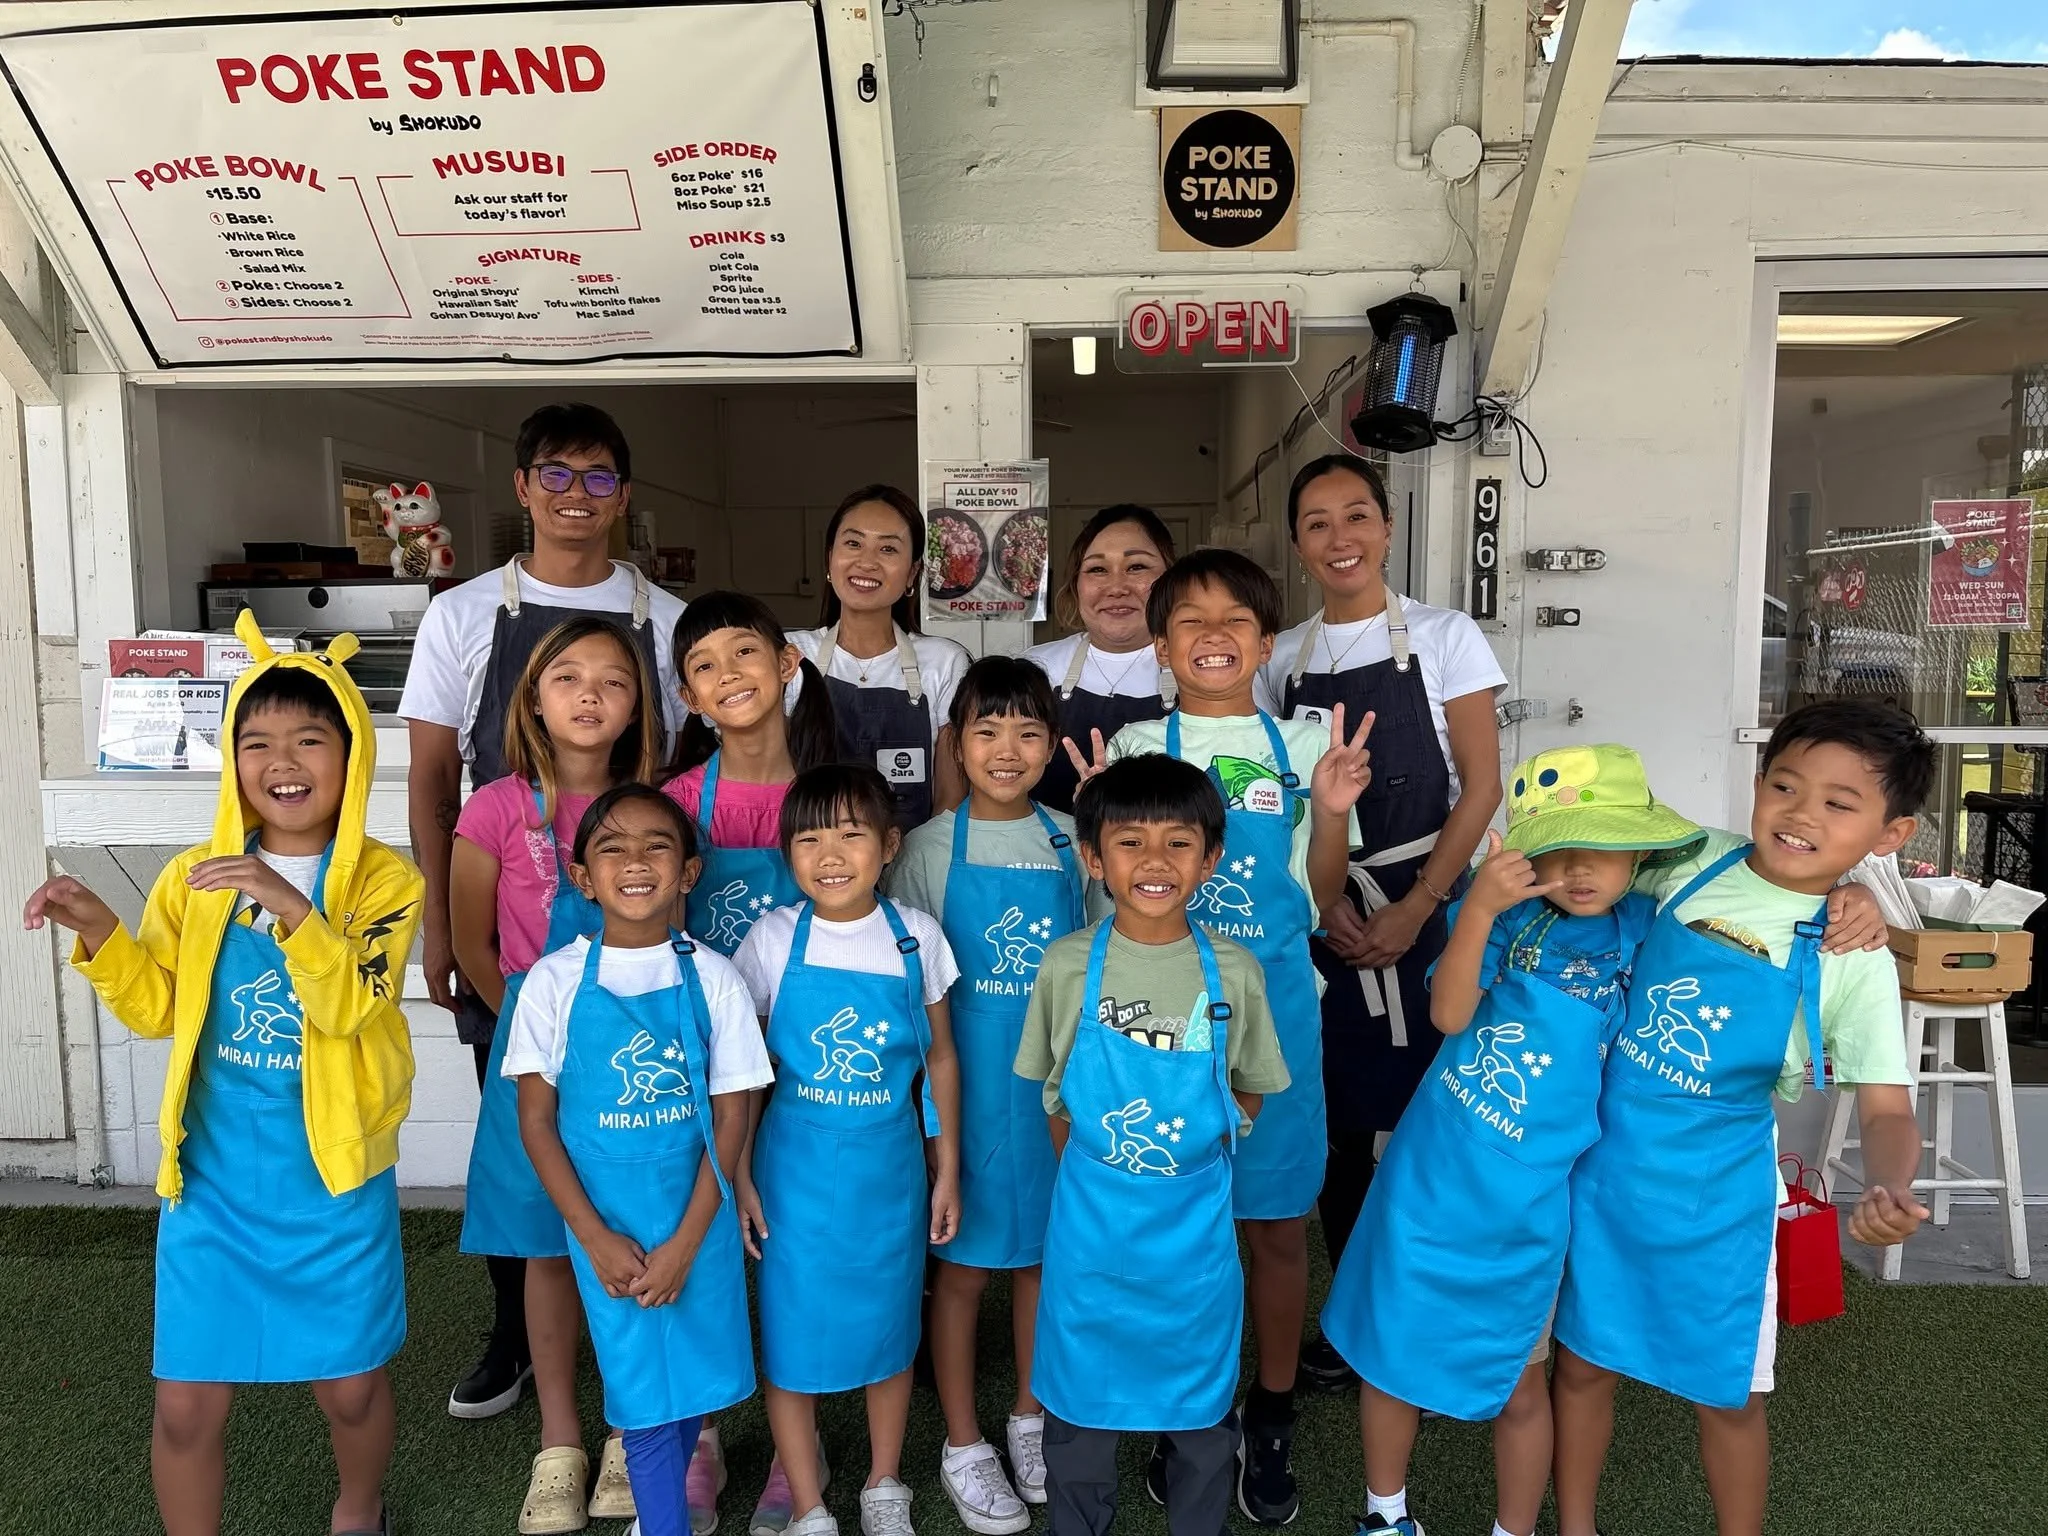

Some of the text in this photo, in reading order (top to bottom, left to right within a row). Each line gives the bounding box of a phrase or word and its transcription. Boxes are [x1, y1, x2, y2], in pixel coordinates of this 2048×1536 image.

[216, 44, 606, 103] POKE STAND
[369, 114, 482, 135] by SHOKUDO
[653, 142, 777, 168] SIDE ORDER
[1188, 145, 1271, 170] POKE
[432, 150, 565, 180] MUSUBI
[134, 155, 326, 193] POKE BOWL
[671, 172, 696, 182] 6oz
[741, 168, 763, 179] $16
[206, 186, 262, 200] $15.50
[674, 186, 699, 197] 8oz
[743, 183, 765, 193] $21
[1180, 176, 1278, 202] STAND
[454, 192, 568, 205] Ask our staff for
[677, 197, 771, 211] Miso Soup $2.5
[225, 212, 274, 225] Base:
[464, 207, 566, 221] today's flavor!
[1195, 207, 1263, 220] by SHOKUDO
[221, 231, 296, 241] White Rice
[689, 230, 786, 249] DRINKS $3
[228, 247, 304, 258] Brown Rice
[478, 248, 582, 268] SIGNATURE
[719, 252, 745, 260] Cola
[243, 263, 306, 273] Salad Mix
[709, 263, 759, 272] Diet Cola
[455, 276, 491, 285] POKE
[577, 274, 614, 283] SIDES
[720, 274, 753, 283] Sprite
[231, 279, 281, 291] Poke:
[283, 281, 332, 291] Choose
[334, 281, 344, 290] 2
[578, 286, 620, 296] Kimchi
[712, 285, 764, 294] POG juice
[432, 288, 479, 298] Original
[240, 296, 290, 308] Sides:
[292, 298, 342, 307] Choose
[343, 298, 353, 307] 2
[438, 299, 492, 309] Hawaiian
[544, 296, 661, 308] Tofu with bonito flakes
[708, 295, 781, 304] Green tea $3.5
[430, 311, 468, 320] Gohan
[469, 310, 515, 321] Desuyo!
[576, 308, 635, 319] Mac Salad
[701, 306, 787, 315] Bottled water $2
[1128, 300, 1289, 357] OPEN
[215, 335, 333, 346] @pokestandbyshokudo
[957, 488, 1018, 496] ALL DAY $10
[955, 499, 985, 507] POKE
[1966, 510, 1996, 519] POKE
[1959, 581, 2005, 590] WED-SUN
[950, 601, 1026, 611] POKE STAND
[128, 648, 189, 657] POKE STAND
[220, 650, 249, 660] POKE
[113, 689, 221, 699] REAL JOBS FOR KIDS
[890, 768, 915, 777] Sara
[1254, 790, 1277, 799] POKE
[1252, 798, 1279, 807] STAND
[1217, 921, 1265, 938] HANA
[1706, 920, 1761, 955] TANOA
[975, 979, 1019, 996] MIRAI
[1118, 1007, 1133, 1023] DO
[1135, 1003, 1147, 1015] IT.
[217, 1043, 303, 1070] MIRAI HAN
[1616, 1032, 1712, 1097] MIRAI HANA
[797, 1083, 891, 1107] MIRAI HANA
[1439, 1067, 1525, 1143] MIRAI HANA
[599, 1112, 650, 1129] MIRAI
